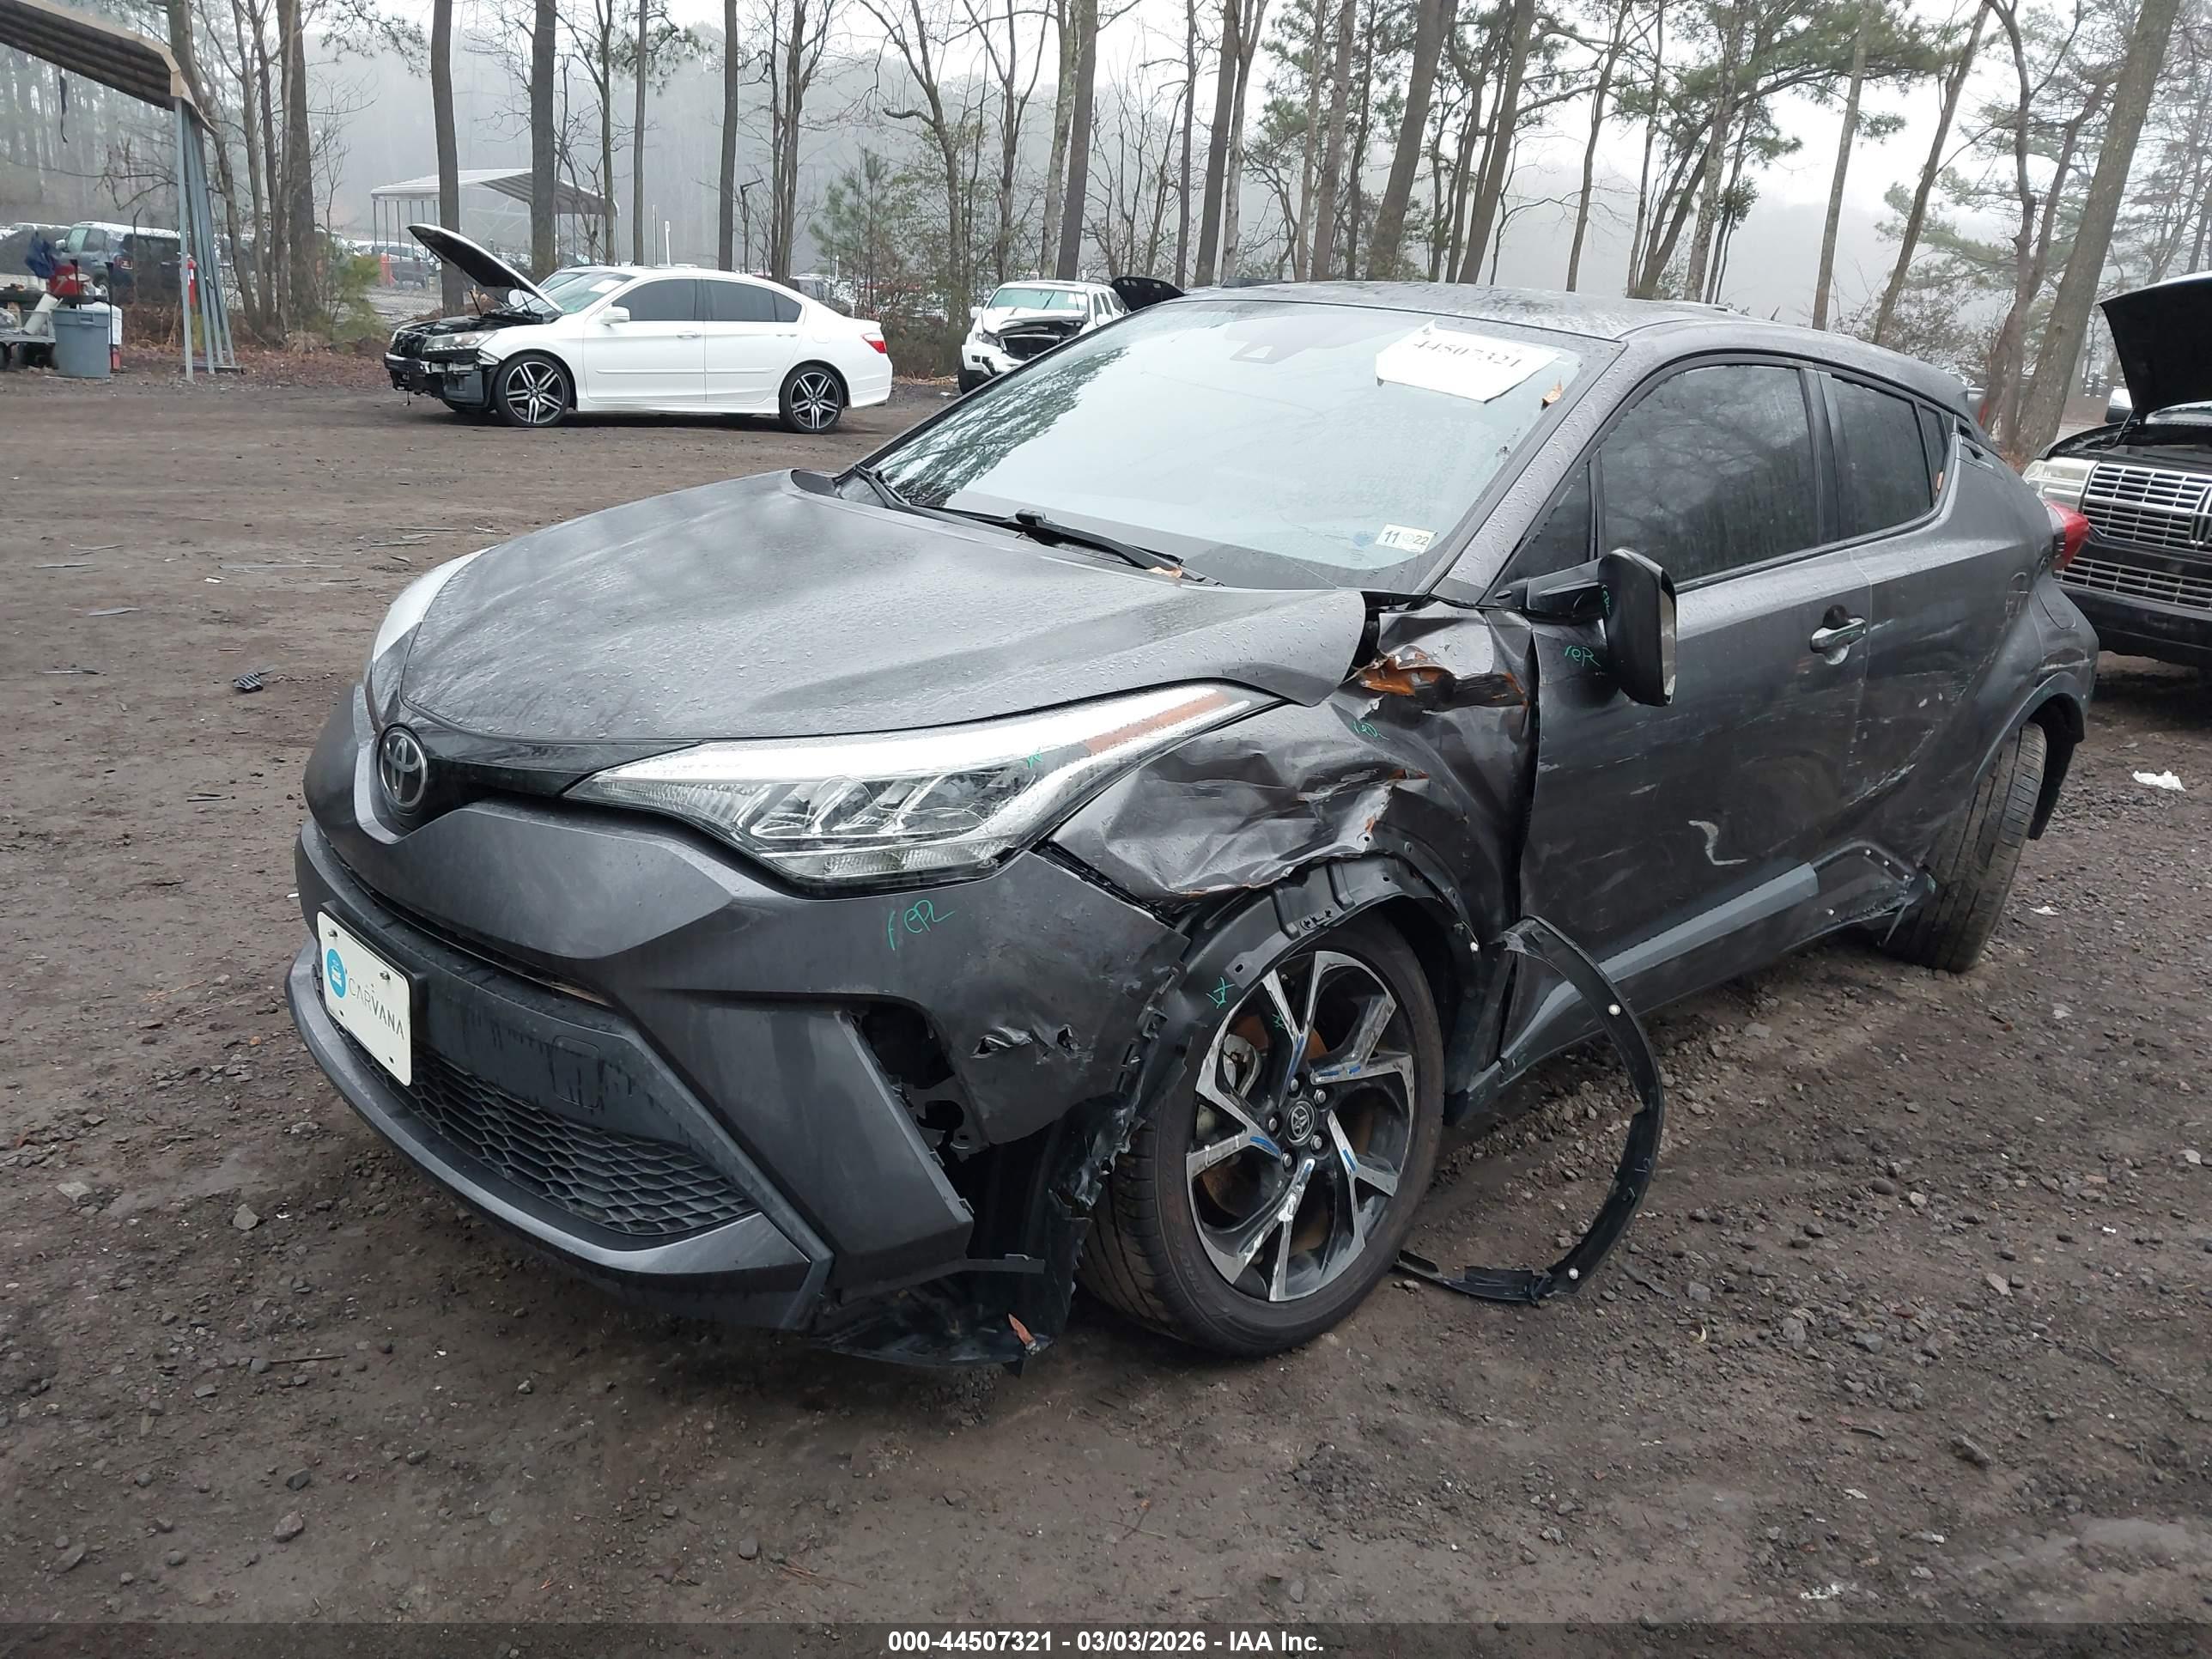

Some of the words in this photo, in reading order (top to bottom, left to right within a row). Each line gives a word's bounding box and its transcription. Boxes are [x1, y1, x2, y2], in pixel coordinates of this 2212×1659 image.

[1383, 530, 1401, 544] 11
[1413, 534, 1430, 546] 22
[348, 977, 405, 1041] CARVANA
